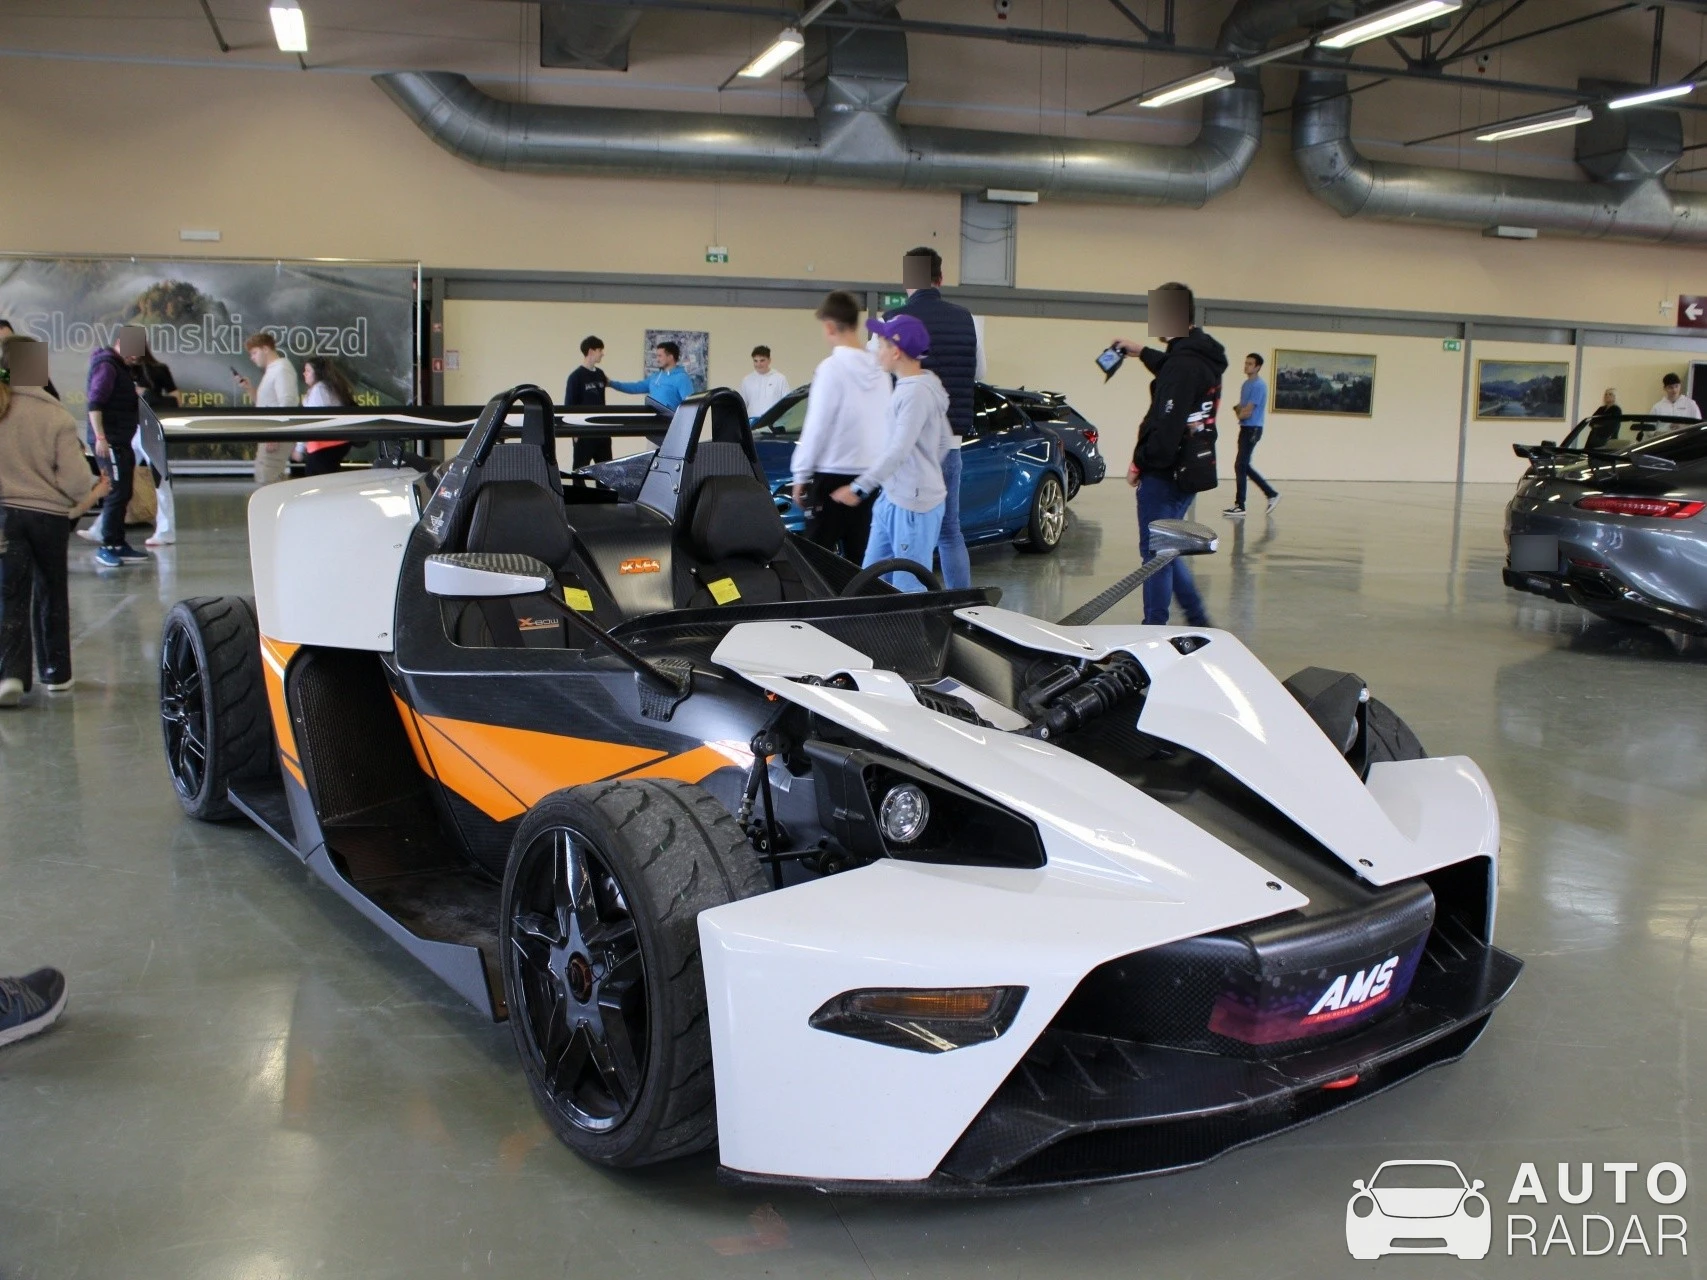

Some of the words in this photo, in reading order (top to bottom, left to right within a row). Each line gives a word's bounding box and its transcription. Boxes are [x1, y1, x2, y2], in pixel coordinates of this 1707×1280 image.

[22, 311, 242, 355] Slovnski
[181, 390, 224, 408] rajen
[1307, 955, 1400, 1015] AMS
